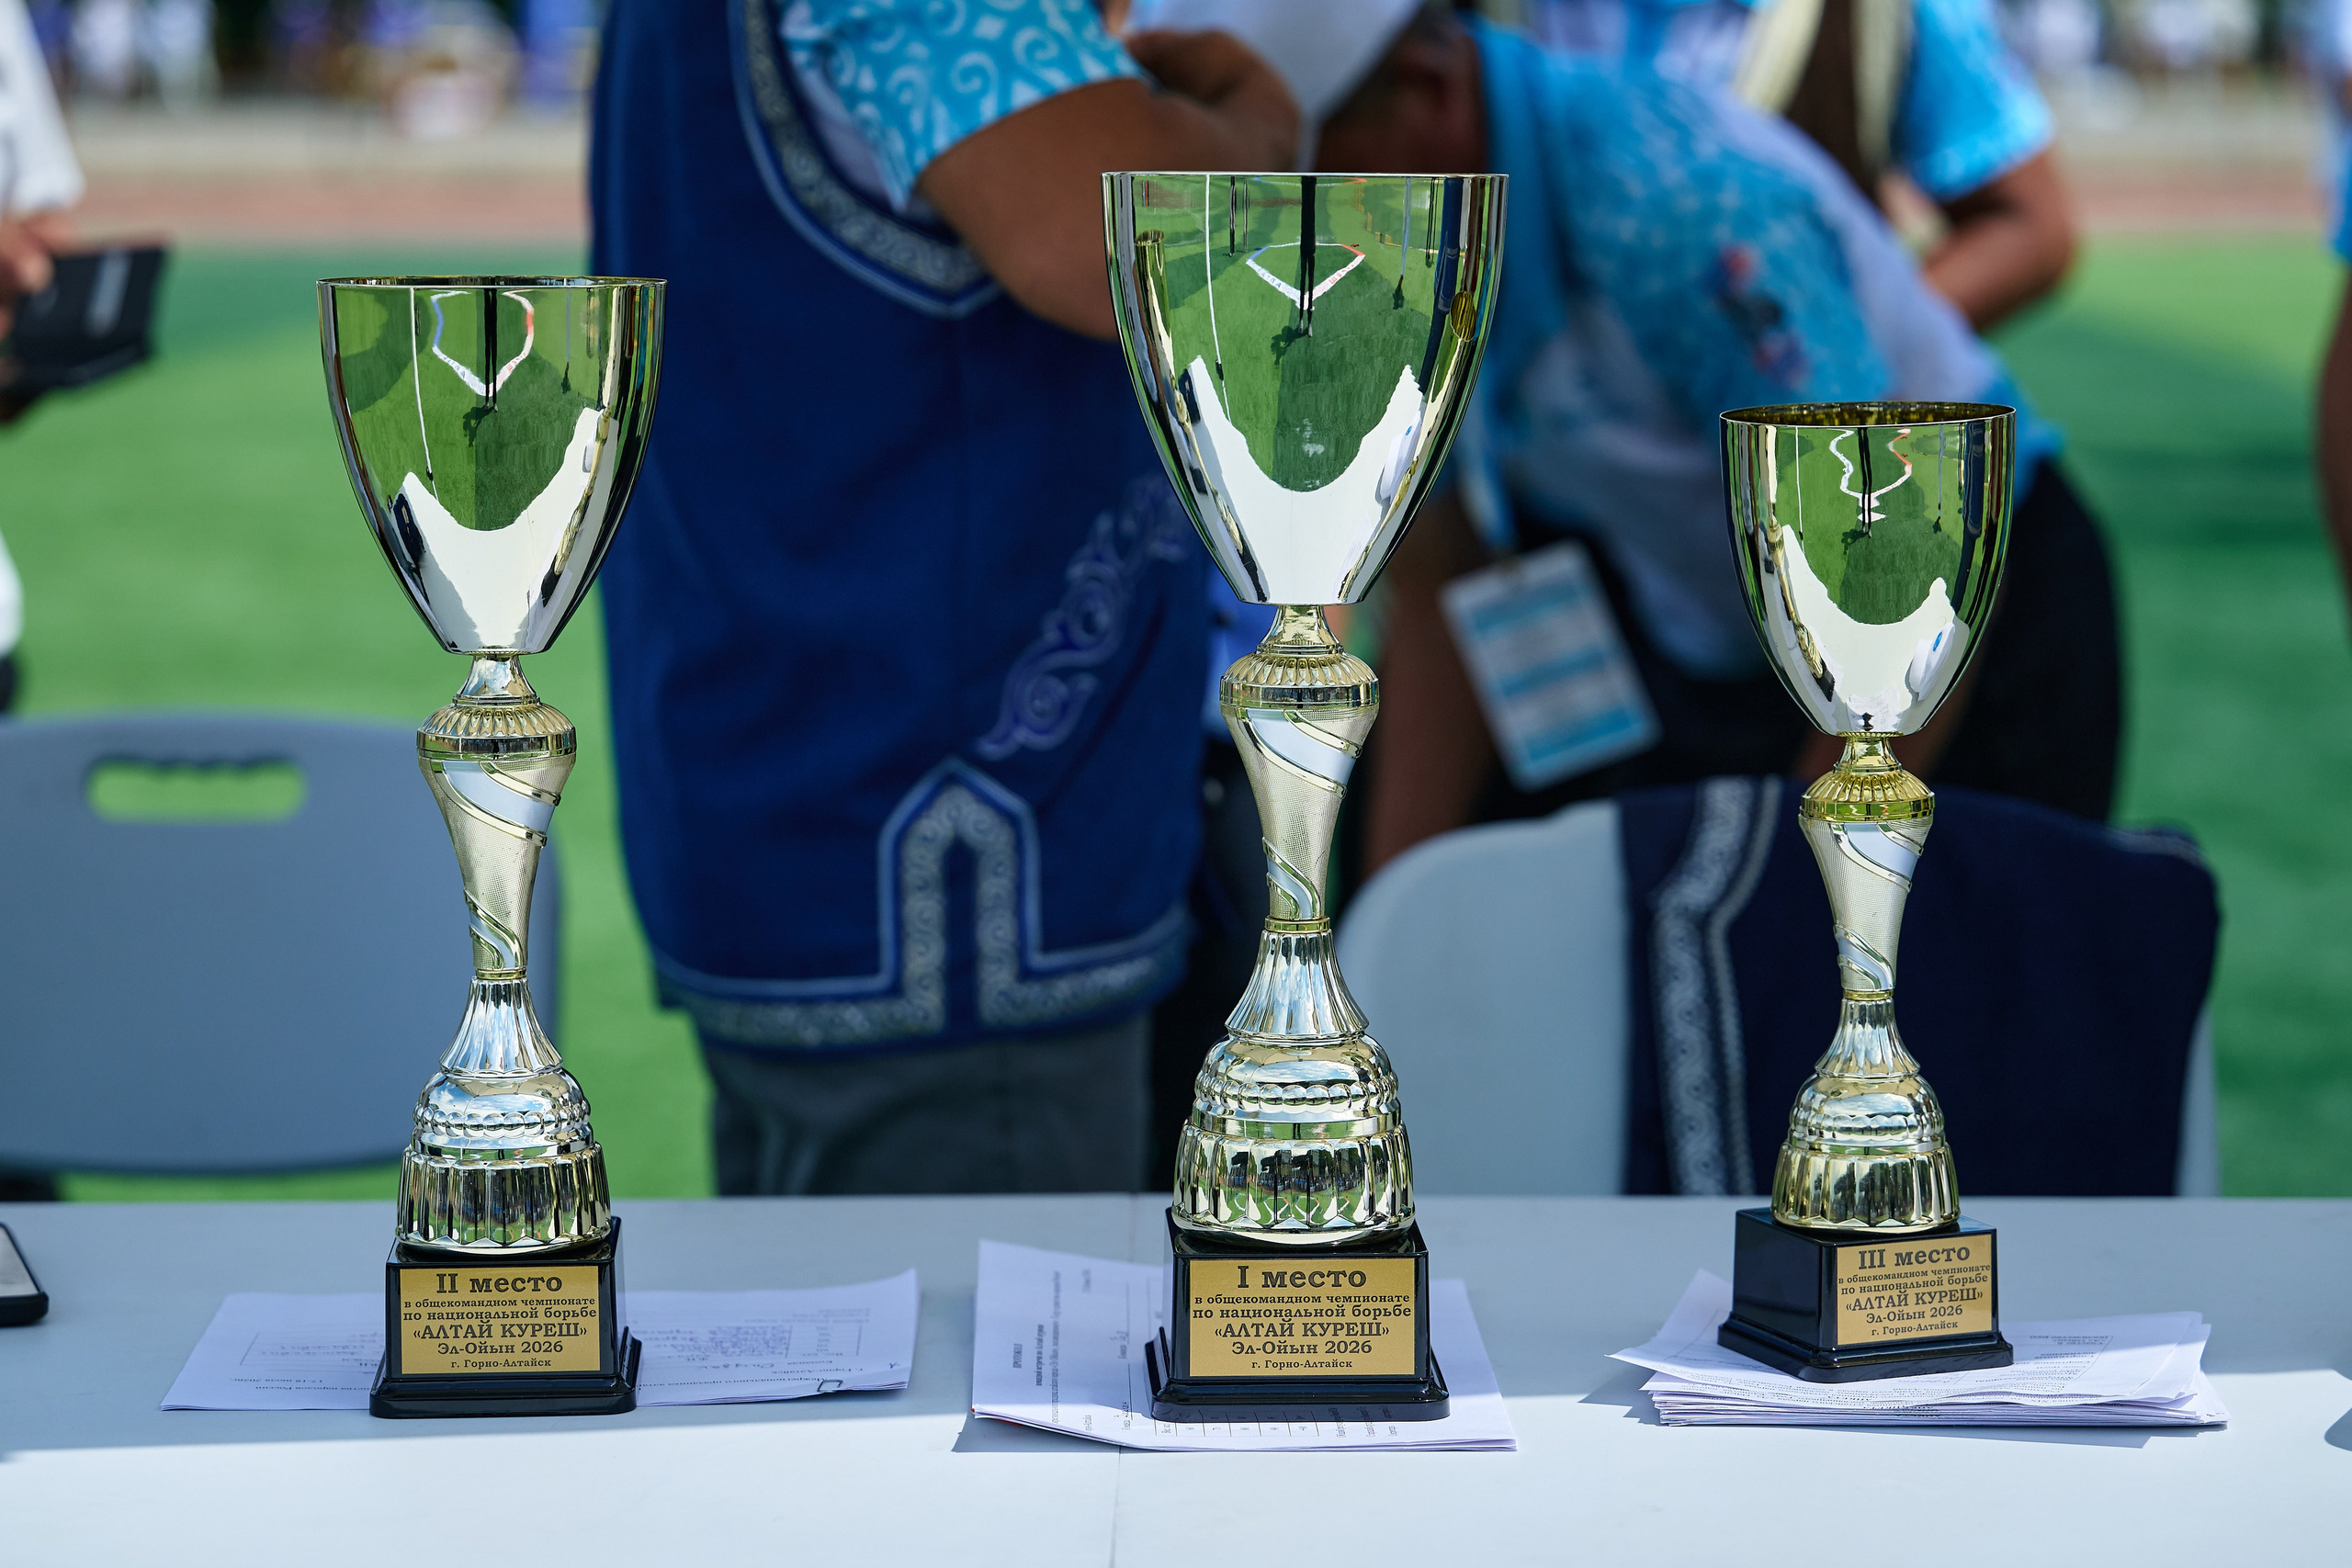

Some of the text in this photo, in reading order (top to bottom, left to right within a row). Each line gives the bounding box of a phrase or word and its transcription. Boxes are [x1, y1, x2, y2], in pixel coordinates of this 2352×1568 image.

[1859, 1246, 1971, 1269] III место
[1238, 1265, 1367, 1289] I место
[1847, 1270, 1928, 1283] общекомандном
[1931, 1263, 1991, 1276] чемпионате
[436, 1273, 562, 1294] II место
[1841, 1273, 1988, 1295] по национальной борьбе
[415, 1298, 517, 1308] общекомандном
[521, 1296, 595, 1306] чемпионате
[1206, 1294, 1322, 1304] общекомандном
[1326, 1293, 1410, 1304] чемпионате
[1846, 1287, 1984, 1312] «АЛТАЙ КУРЕШ»
[403, 1307, 597, 1321] по национальной борьбе
[1193, 1303, 1411, 1319] по национальной борьбе
[1866, 1304, 1963, 1324] Эл-Ойын 2026
[413, 1320, 587, 1339] «АЛТАЙ КУРЕШ»
[1215, 1318, 1389, 1338] «АЛТАЙ КУРЕШ»
[1883, 1320, 1959, 1336] Горно-Алтайск
[437, 1340, 563, 1355] Эл-Ойын 2026
[1231, 1340, 1373, 1355] Эл-Ойын 2026
[464, 1359, 551, 1370] Горно-Алтайск
[1264, 1359, 1353, 1371] Горно-Алтайск
